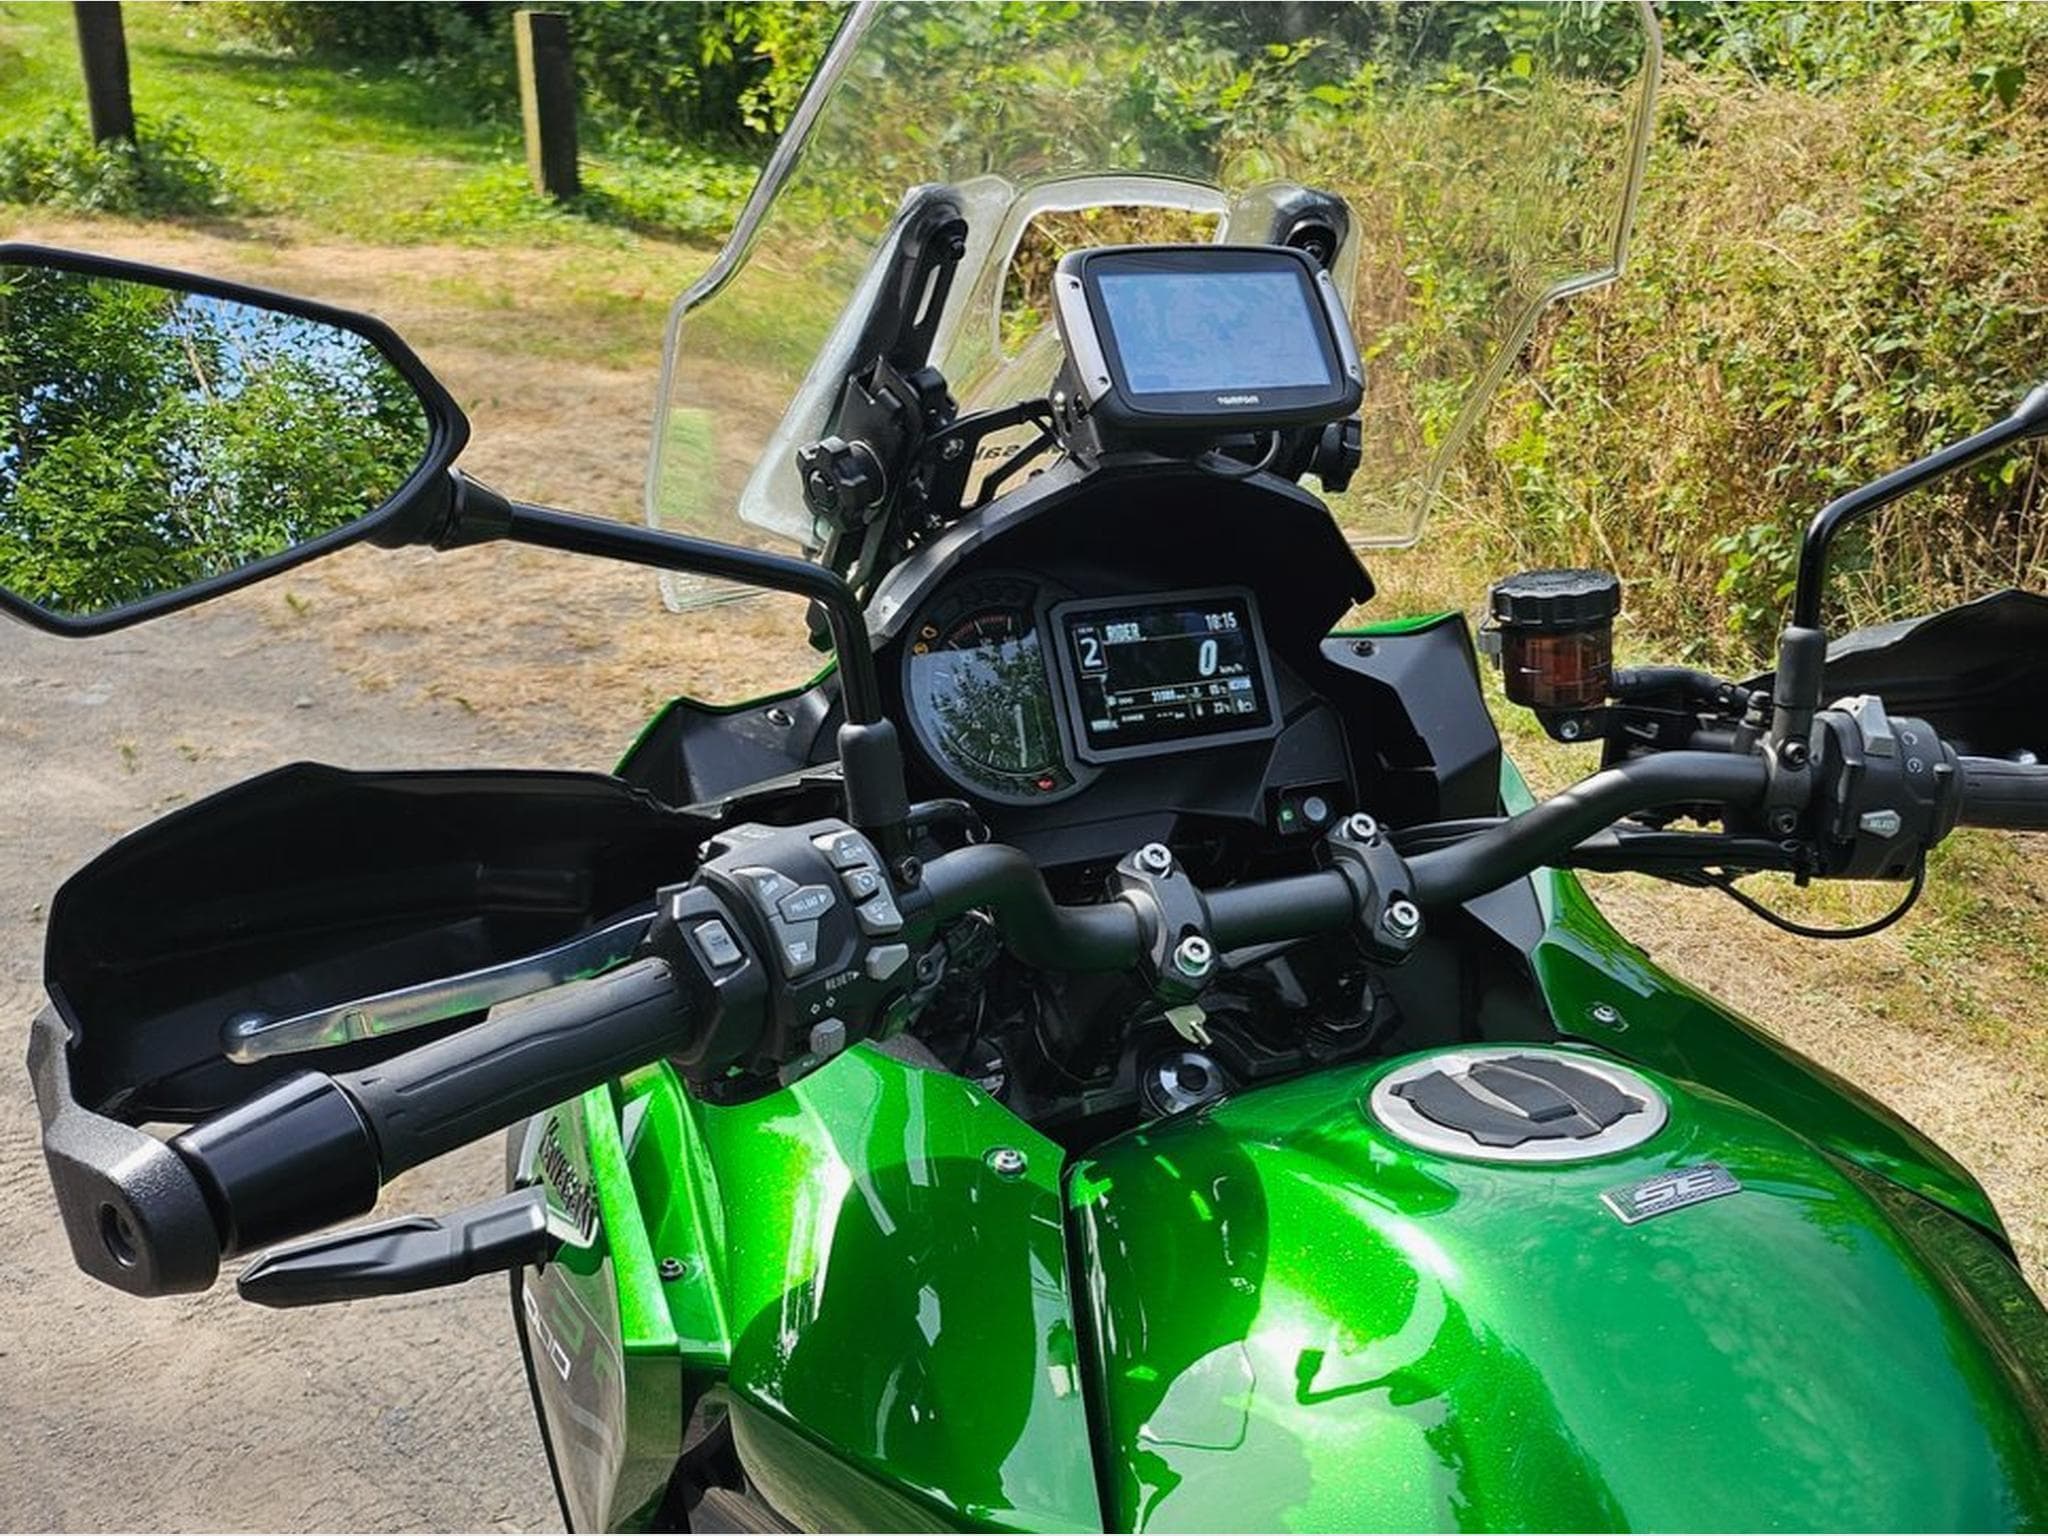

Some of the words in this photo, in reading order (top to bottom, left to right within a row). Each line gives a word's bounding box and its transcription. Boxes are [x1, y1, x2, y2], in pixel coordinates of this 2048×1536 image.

[1079, 637, 1103, 668] 2
[1199, 639, 1218, 676] 0
[1635, 1170, 1713, 1208] SE
